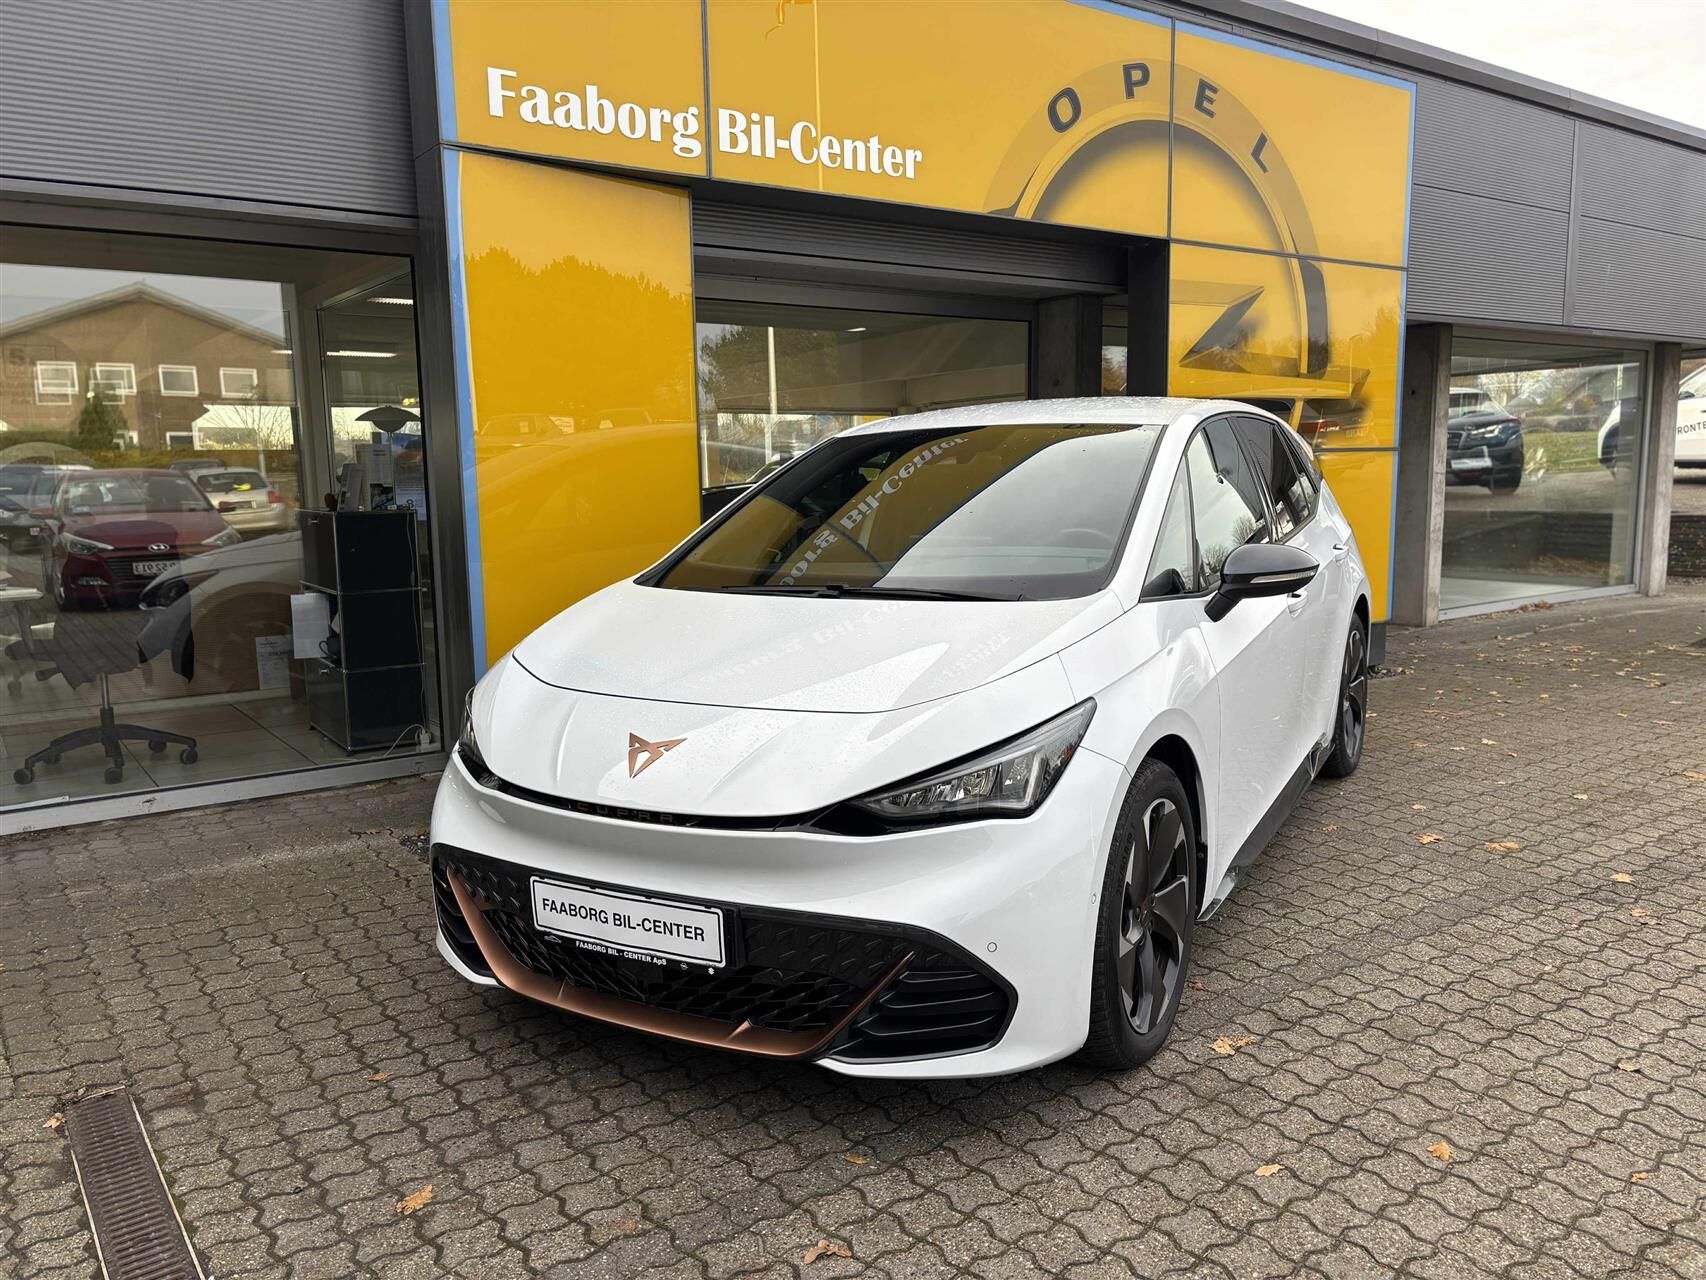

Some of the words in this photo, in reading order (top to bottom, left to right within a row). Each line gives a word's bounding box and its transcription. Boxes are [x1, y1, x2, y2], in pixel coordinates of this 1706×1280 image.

[486, 66, 702, 158] Faaborg
[717, 108, 923, 180] Bil-Center
[1047, 62, 1270, 174] OPEL
[1676, 420, 1706, 435] RONTE
[576, 802, 673, 823] CUPRA
[542, 897, 609, 925] FAABORG
[612, 912, 705, 942] BIL-CENTER
[575, 940, 607, 954] FAABORG
[607, 947, 619, 956] BIL
[623, 951, 652, 963] CENTER
[652, 957, 667, 966] ApS
